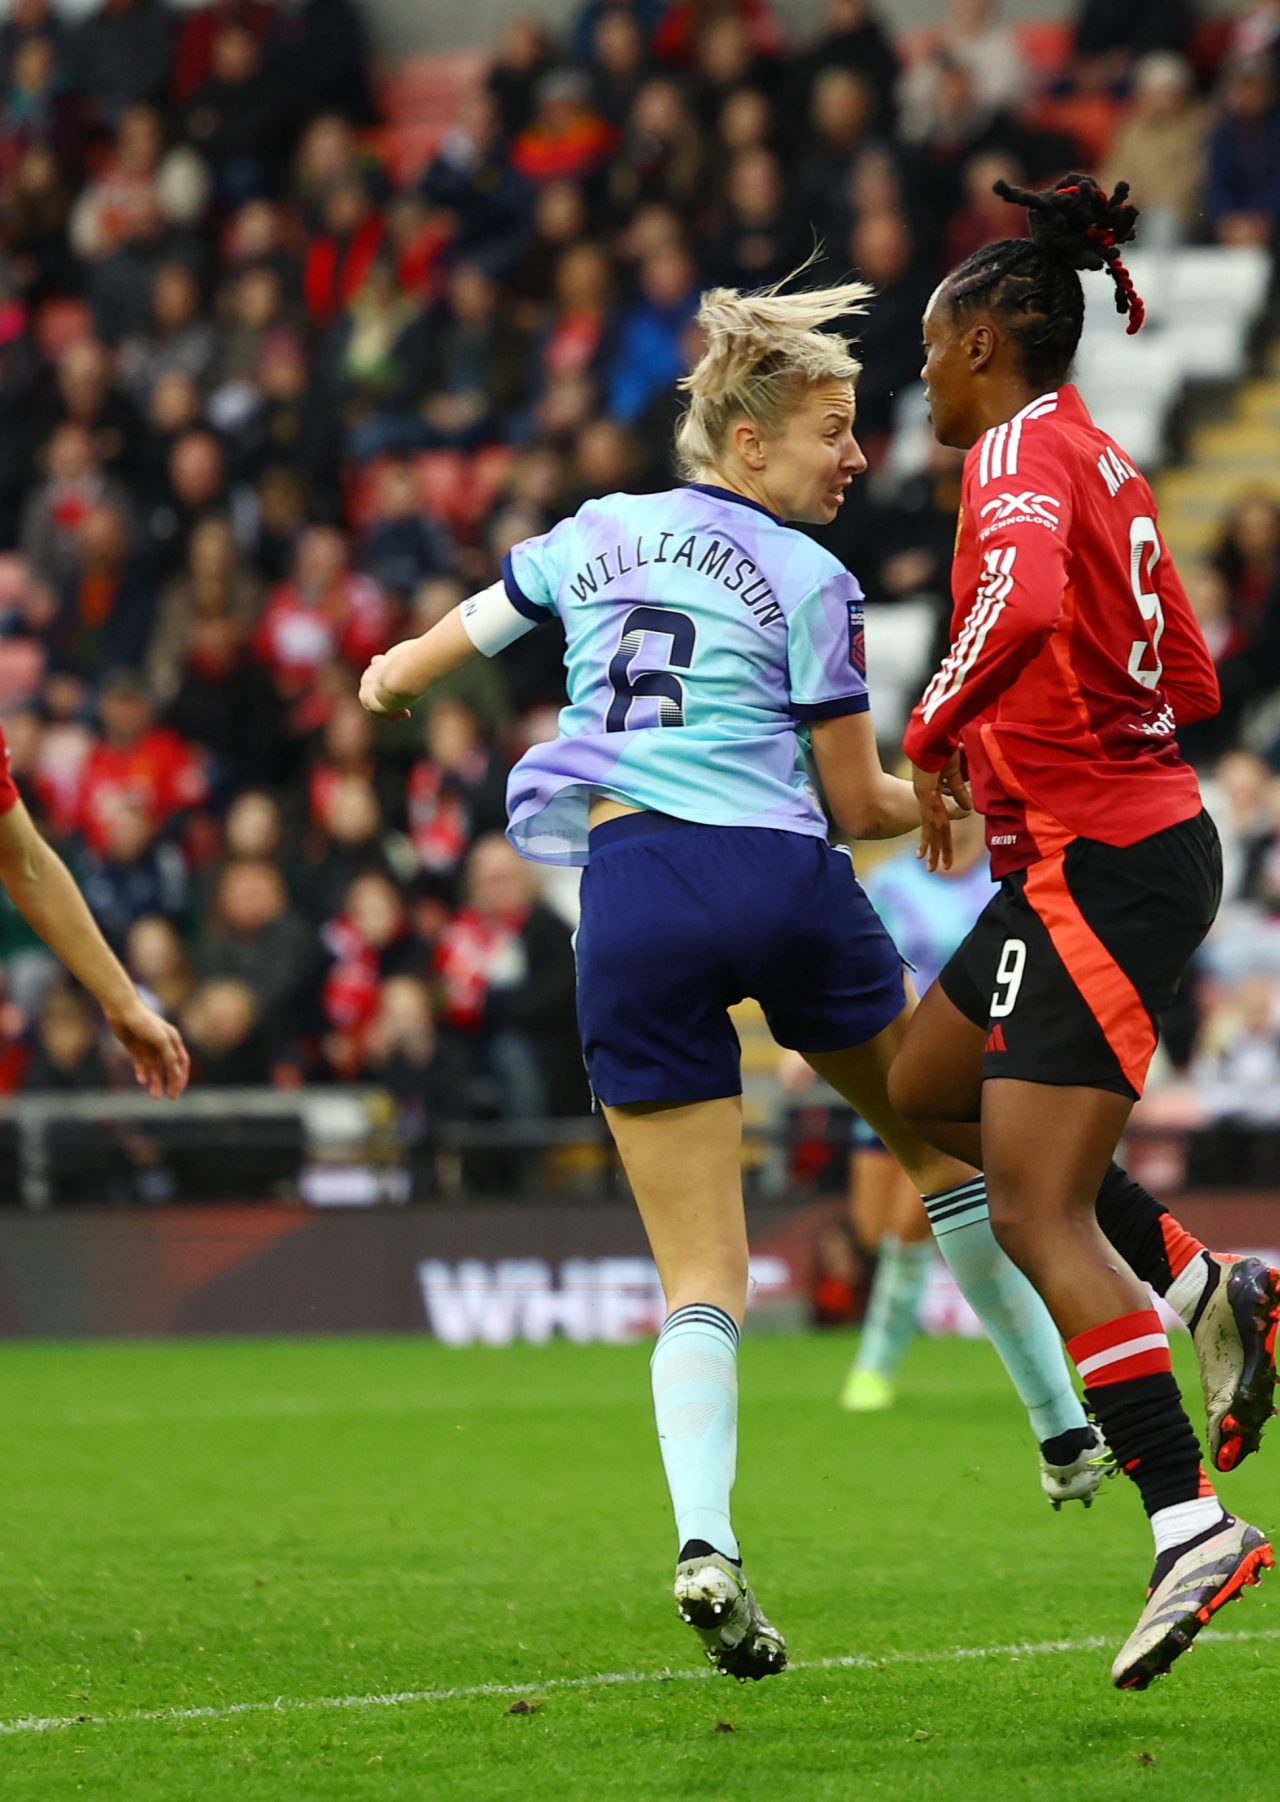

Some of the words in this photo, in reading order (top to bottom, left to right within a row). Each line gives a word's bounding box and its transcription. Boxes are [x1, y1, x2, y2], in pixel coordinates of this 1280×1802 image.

[979, 515, 1057, 541] TECHNOLOGY
[570, 532, 784, 627] WILLIAMSON
[604, 605, 697, 733] 6
[989, 938, 1027, 1018] 9
